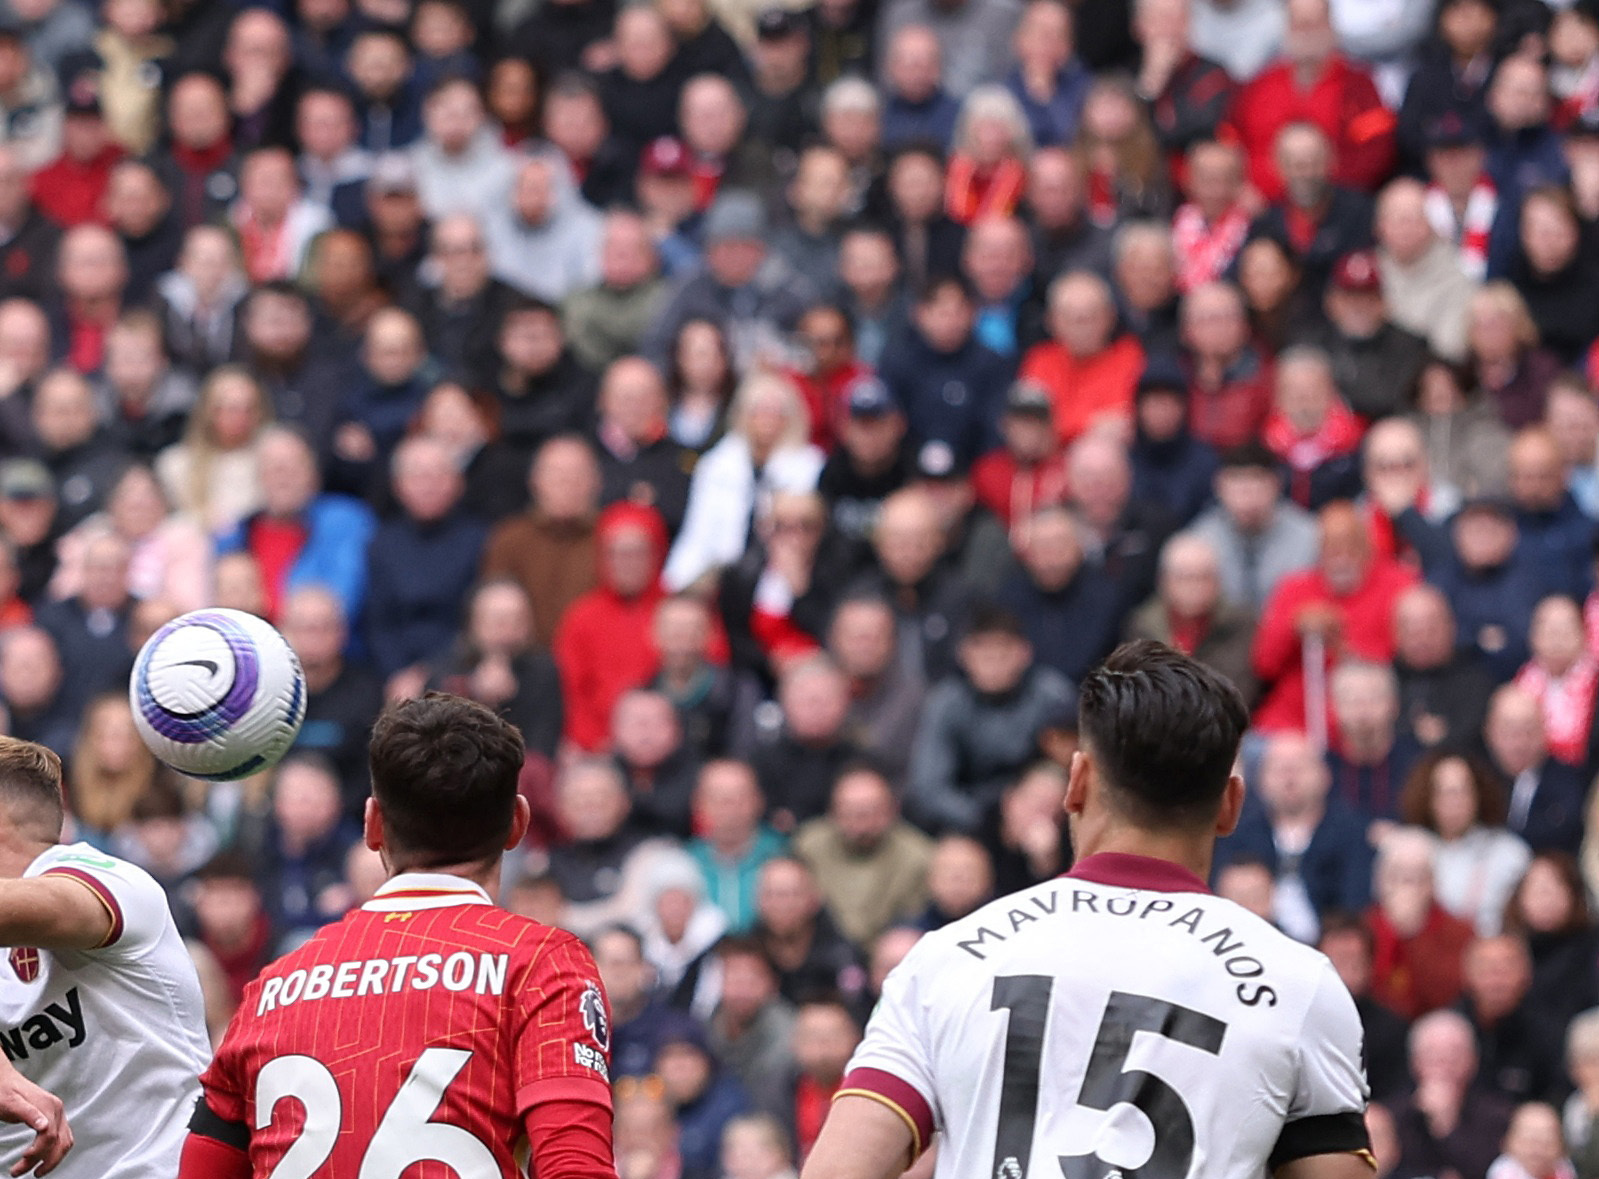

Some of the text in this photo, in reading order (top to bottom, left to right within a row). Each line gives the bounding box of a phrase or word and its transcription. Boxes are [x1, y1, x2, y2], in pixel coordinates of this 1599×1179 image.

[257, 950, 508, 1017] ROBERTSON
[957, 889, 1277, 1009] MAVROPANOS
[0, 986, 87, 1062] way
